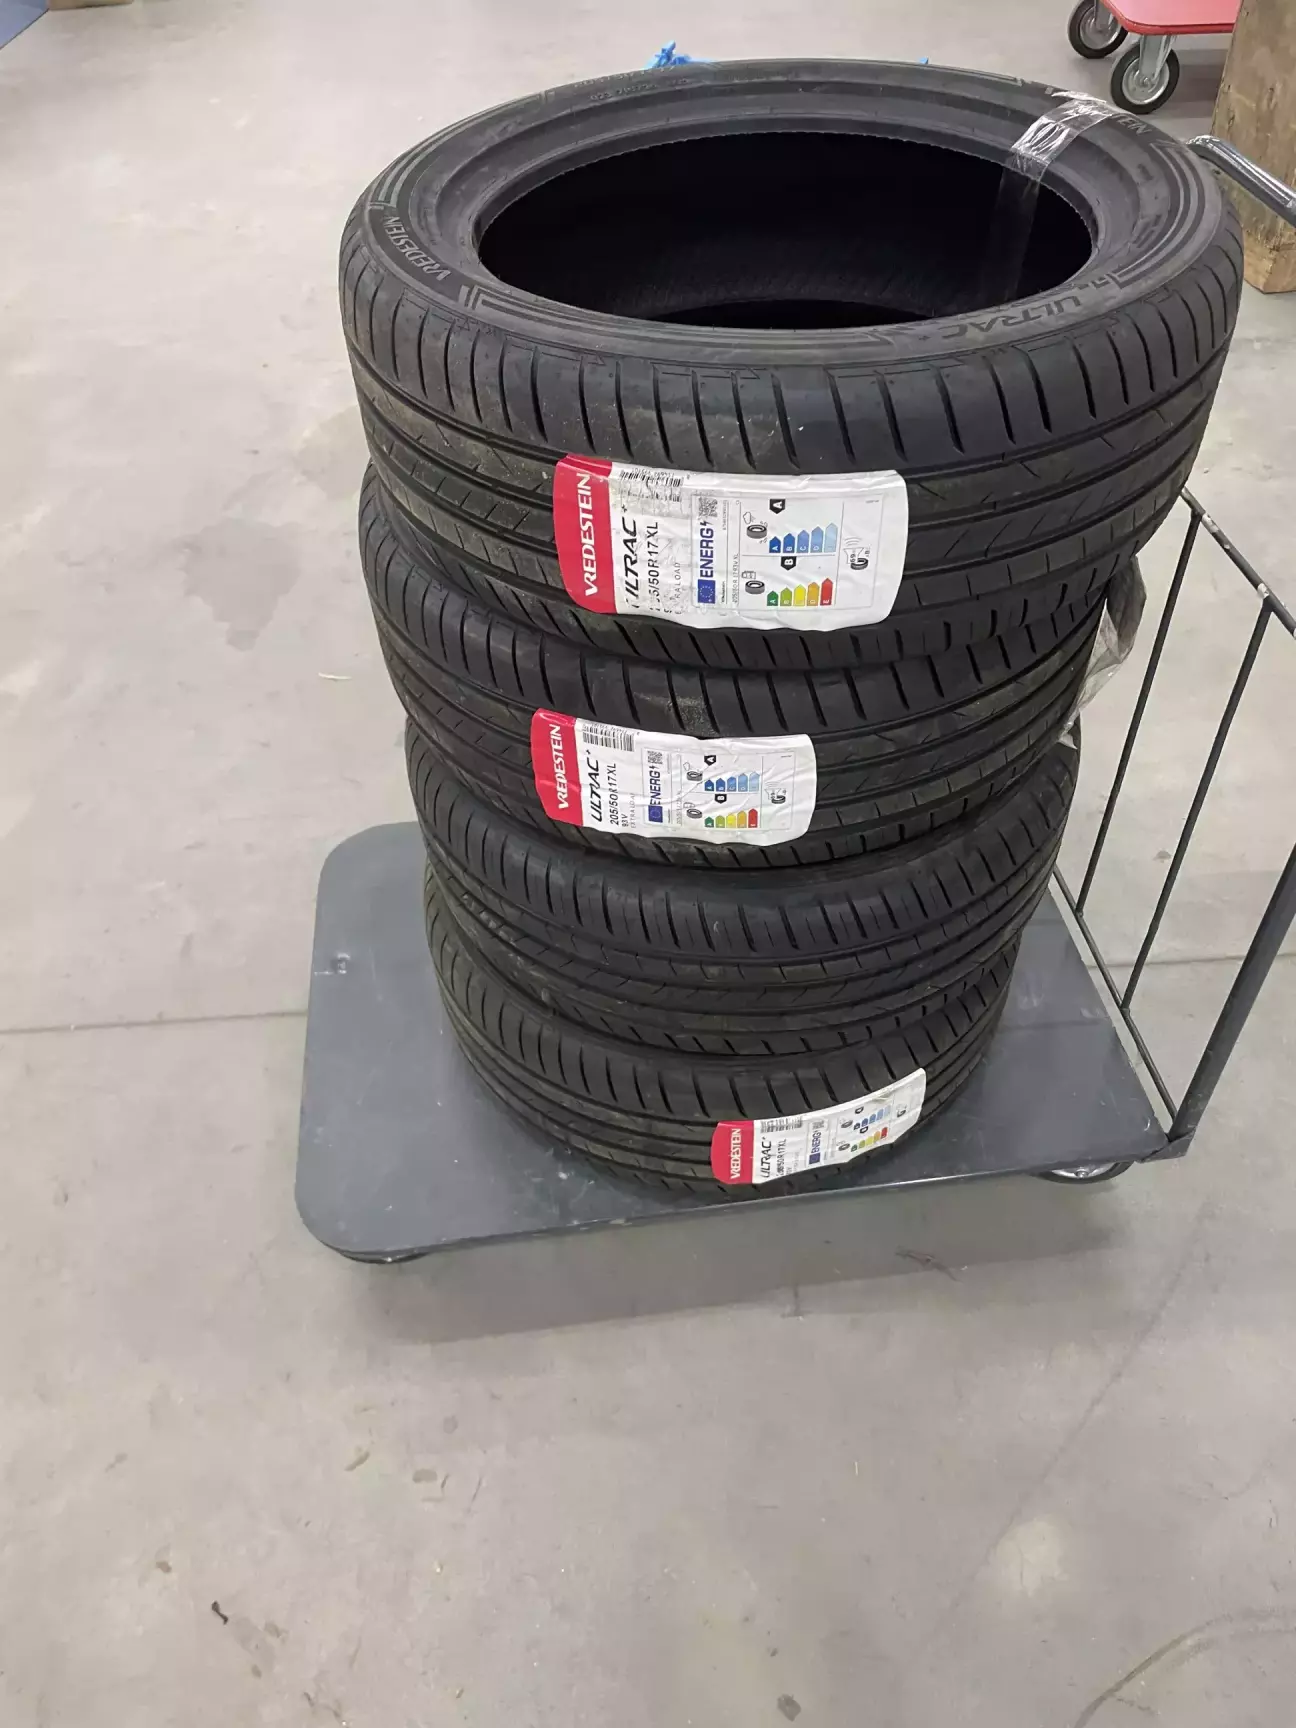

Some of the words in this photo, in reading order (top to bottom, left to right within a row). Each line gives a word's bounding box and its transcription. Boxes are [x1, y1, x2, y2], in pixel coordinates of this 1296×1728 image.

[382, 215, 452, 282] VREDESTEIN
[776, 500, 784, 510] A
[576, 472, 599, 597] VREDESTEIN
[699, 527, 715, 579] ENERG
[784, 557, 794, 567] B
[548, 723, 570, 810] VREDESTEIN
[648, 769, 662, 807] ENERG
